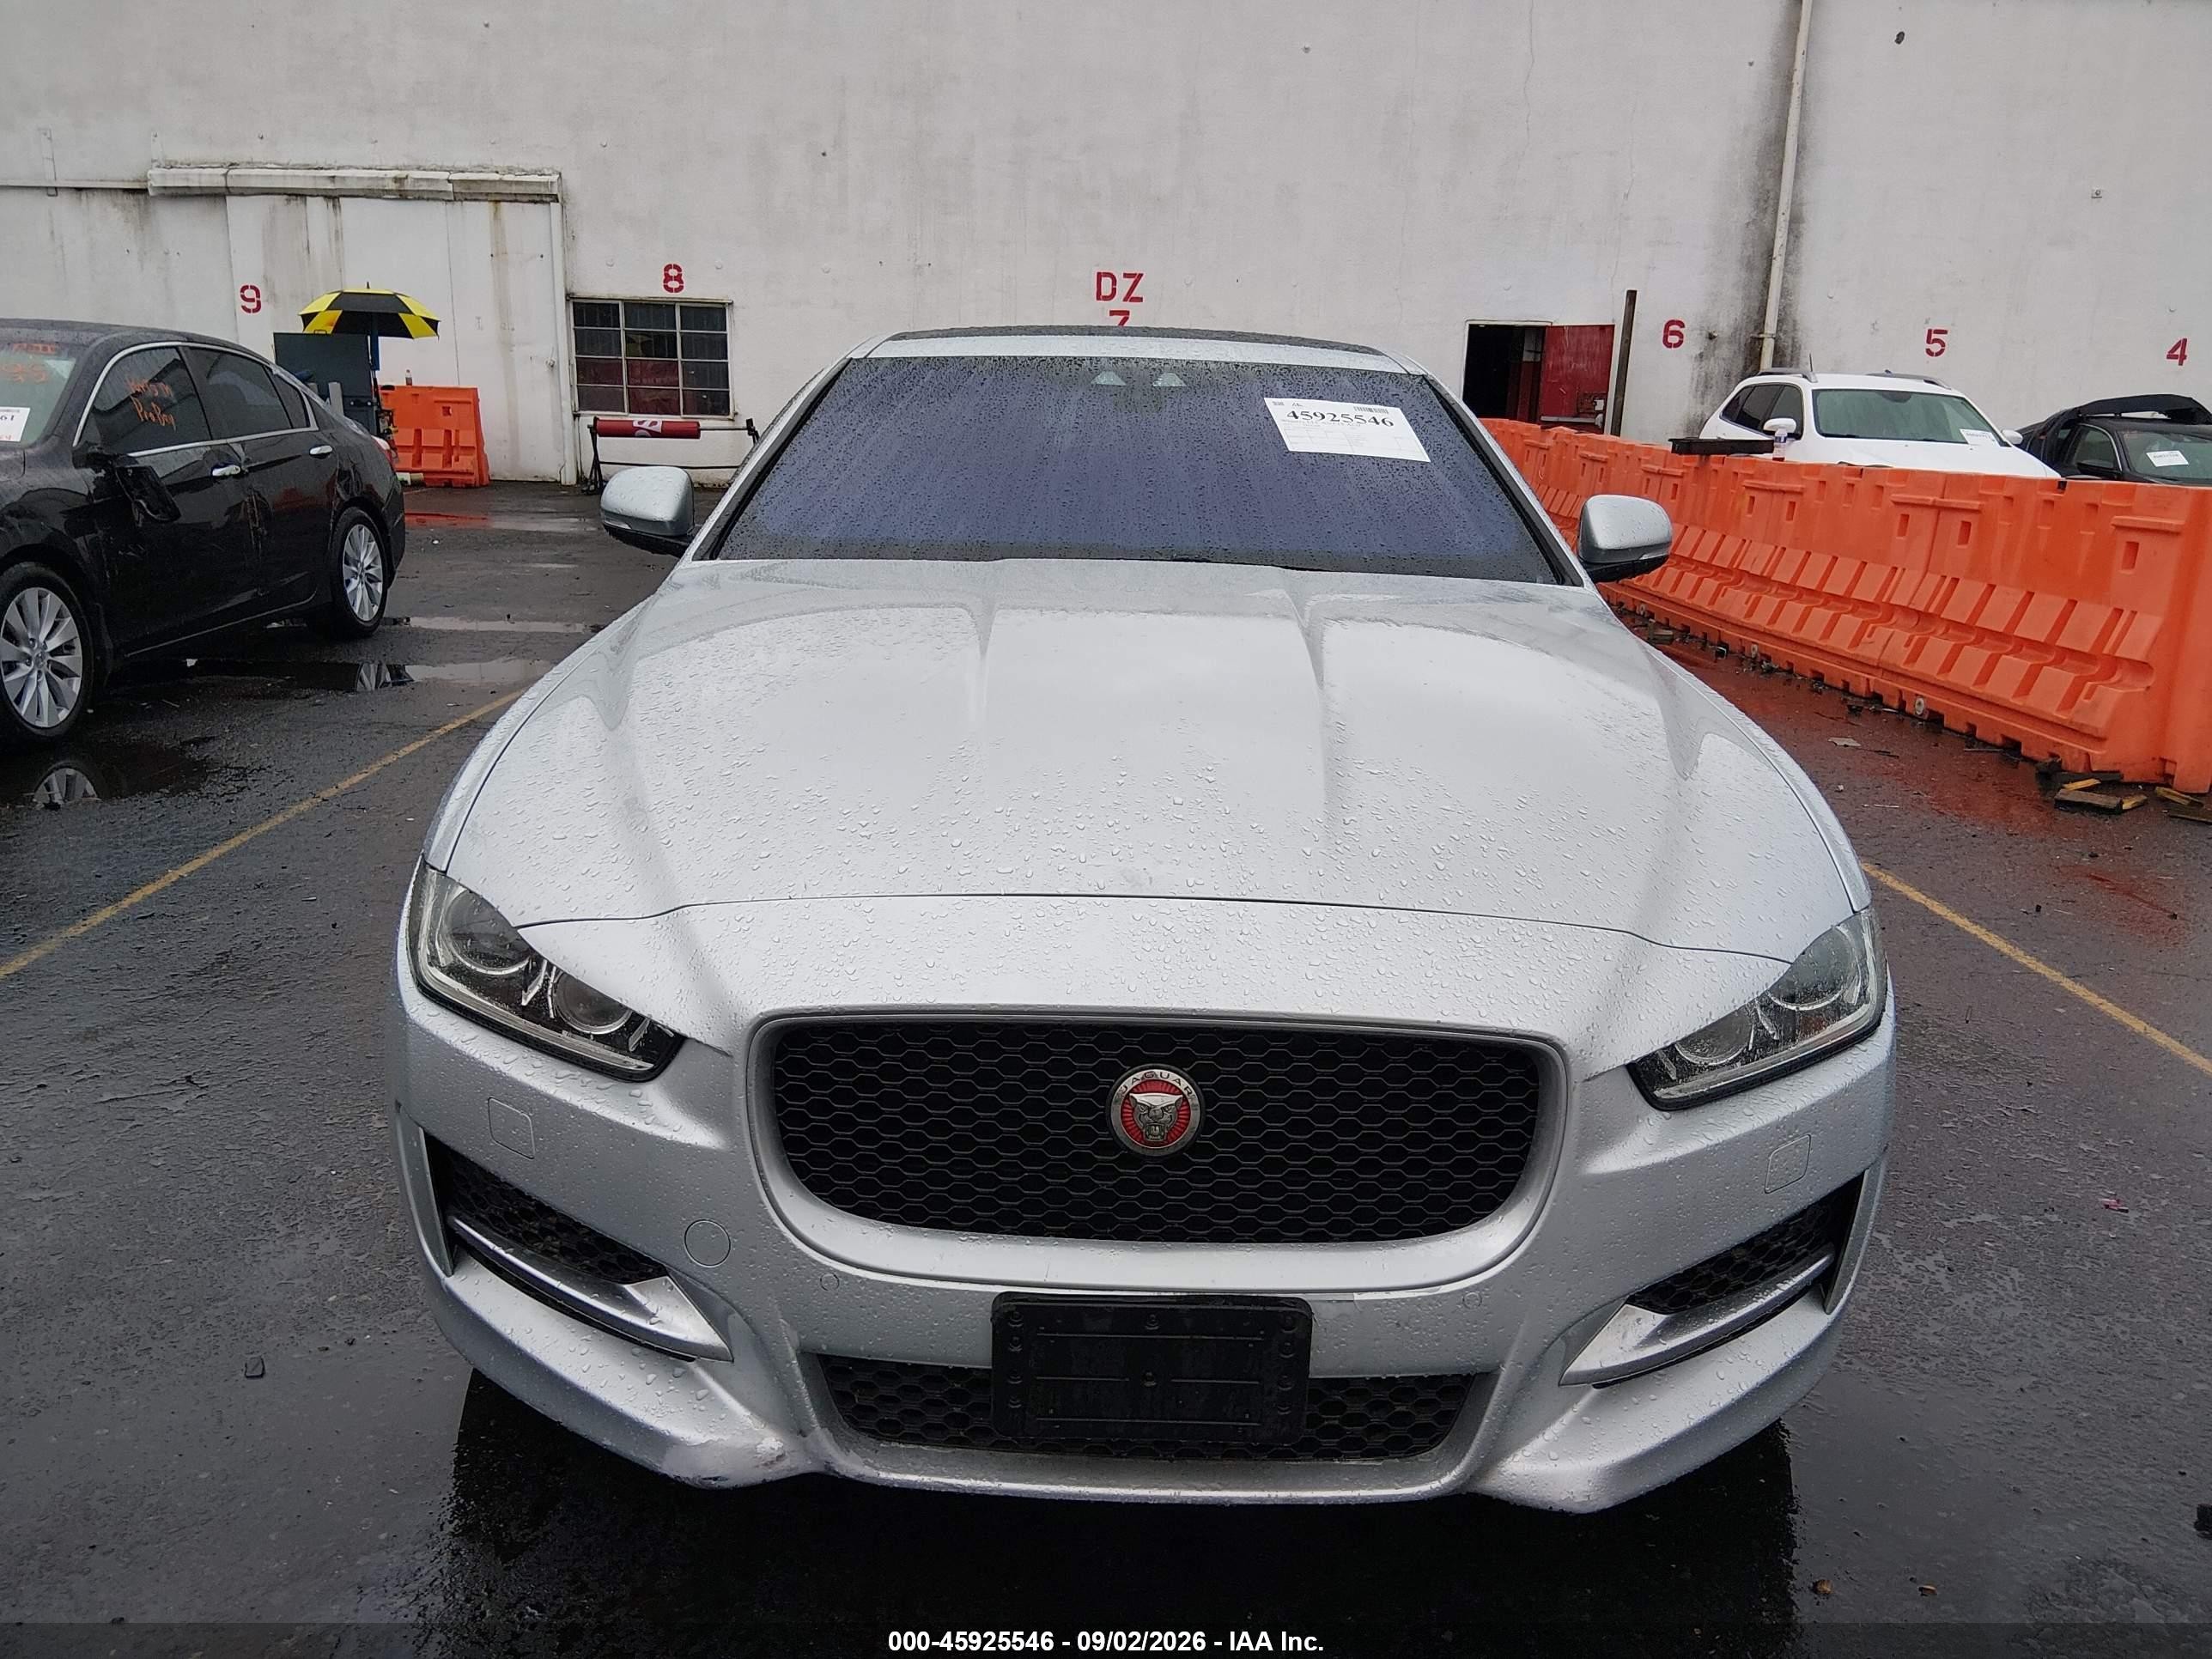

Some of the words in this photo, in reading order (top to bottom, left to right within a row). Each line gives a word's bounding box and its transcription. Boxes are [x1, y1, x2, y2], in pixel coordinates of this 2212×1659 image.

[663, 264, 684, 293] 8
[1096, 271, 1144, 302] DZ
[240, 285, 261, 313] 9
[1662, 319, 1685, 349] 6
[1925, 329, 1948, 357] 5
[2166, 338, 2188, 366] 4
[1286, 410, 1395, 428] 45925546
[1120, 1071, 1193, 1097] JAGUAR
